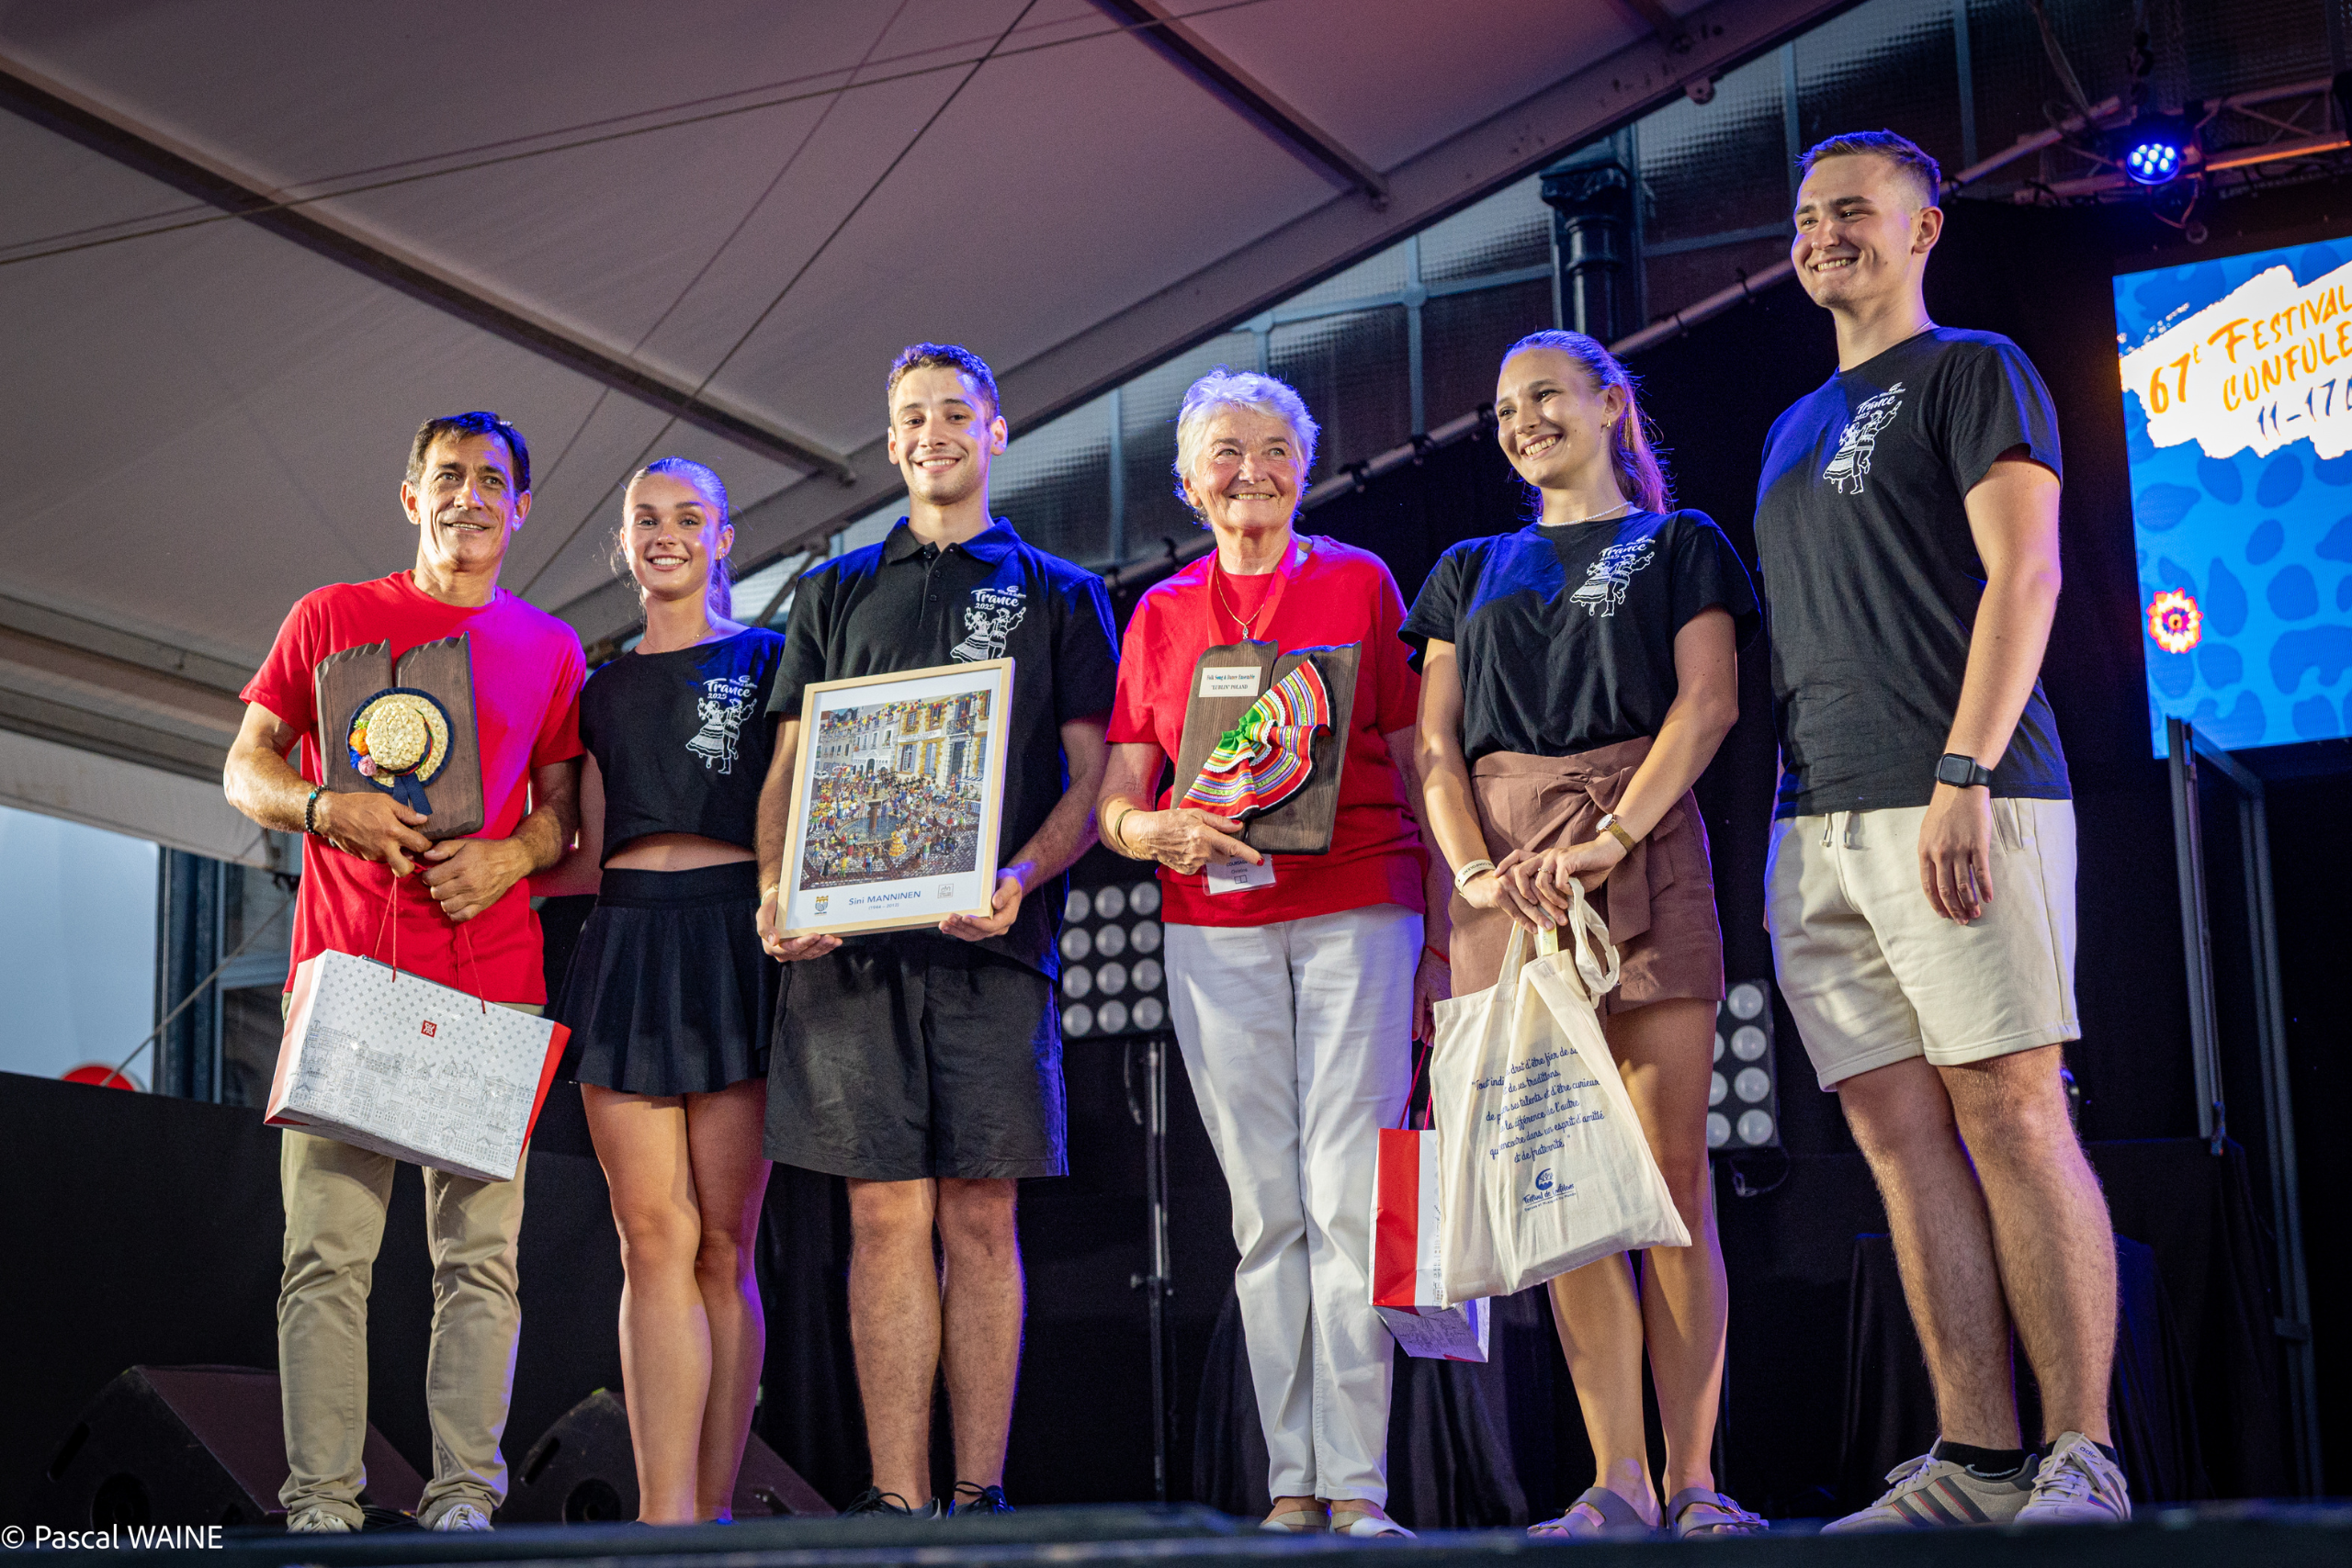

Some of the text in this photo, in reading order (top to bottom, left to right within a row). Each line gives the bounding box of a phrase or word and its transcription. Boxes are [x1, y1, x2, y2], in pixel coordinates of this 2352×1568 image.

[848, 890, 922, 906] Sini MANNINEN
[1544, 1052, 1559, 1066] fier
[1559, 1046, 1569, 1057] de
[1508, 1083, 1517, 1093] de
[1486, 1111, 1496, 1122] de
[1520, 1093, 1544, 1108] talents
[1505, 1119, 1514, 1131] la
[1526, 1129, 1544, 1141] dans
[1554, 1116, 1576, 1133] esprit
[1521, 1147, 1532, 1159] de
